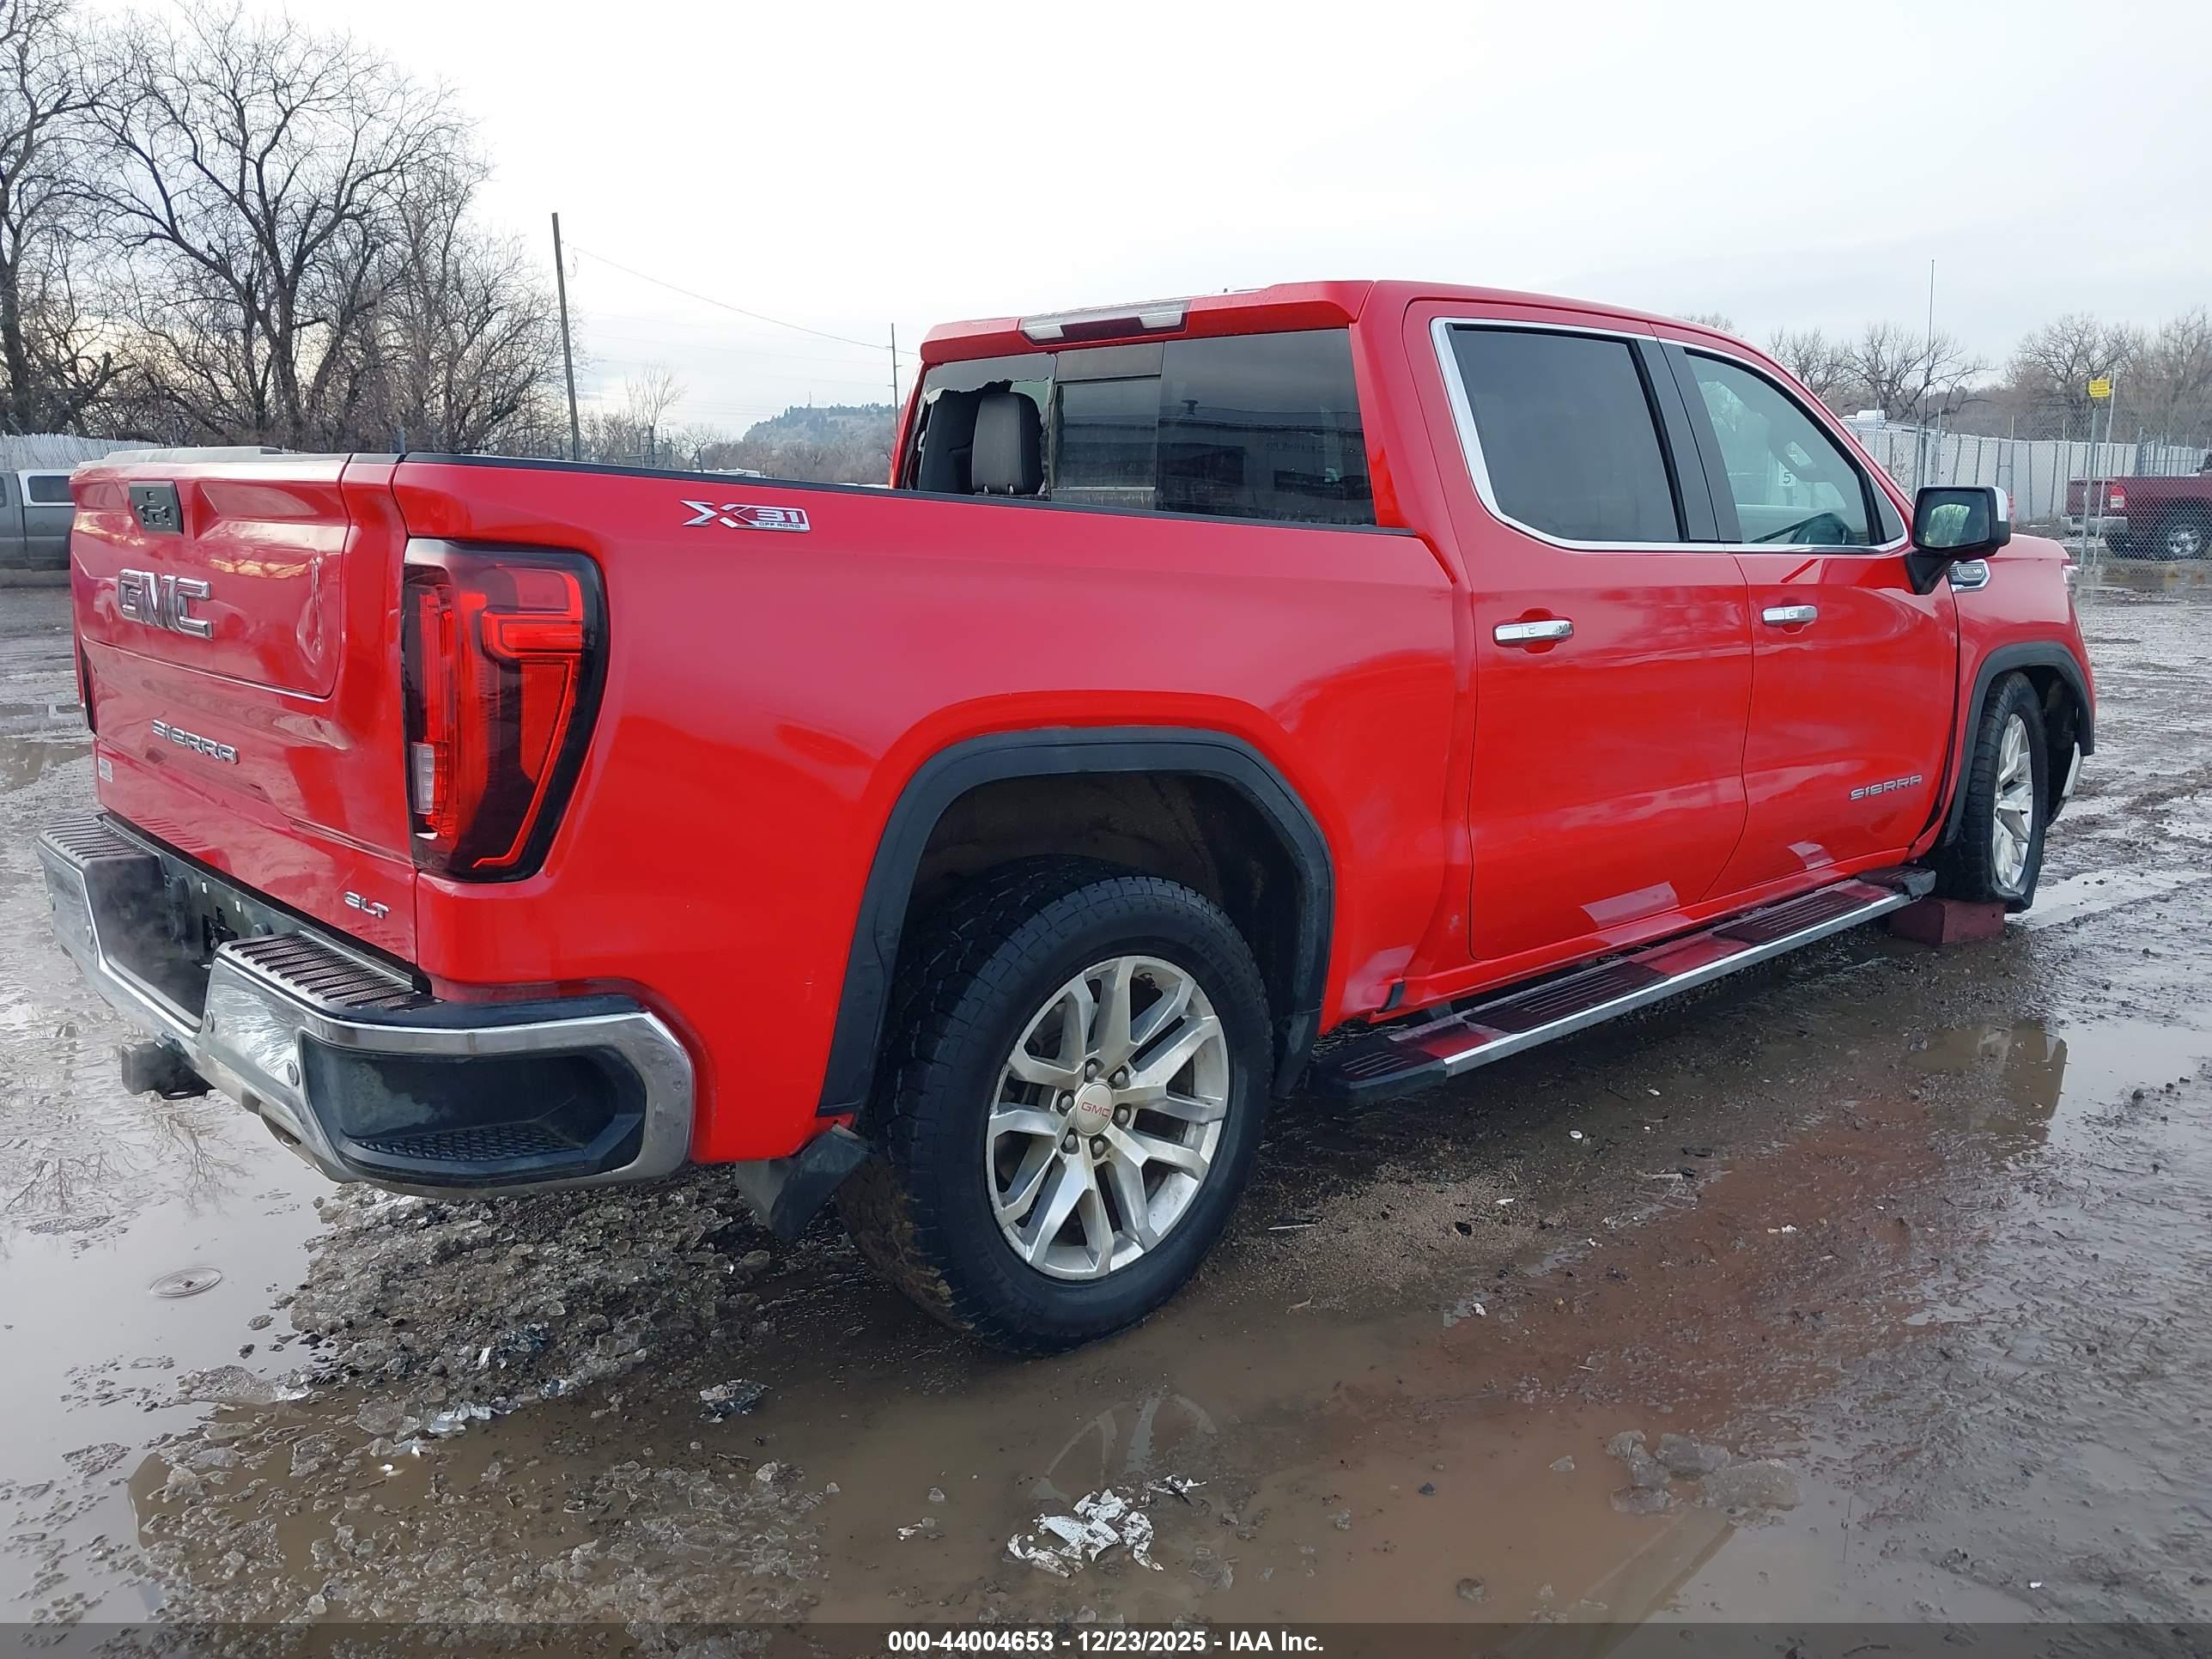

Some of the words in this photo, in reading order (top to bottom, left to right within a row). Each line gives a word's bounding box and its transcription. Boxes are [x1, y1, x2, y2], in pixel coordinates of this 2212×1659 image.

[680, 500, 810, 531] X31
[118, 568, 214, 641] GMC
[151, 719, 240, 764] SIERRA
[1850, 775, 1923, 801] SIERRA
[343, 890, 391, 920] SLT
[1080, 1101, 1111, 1118] GMC
